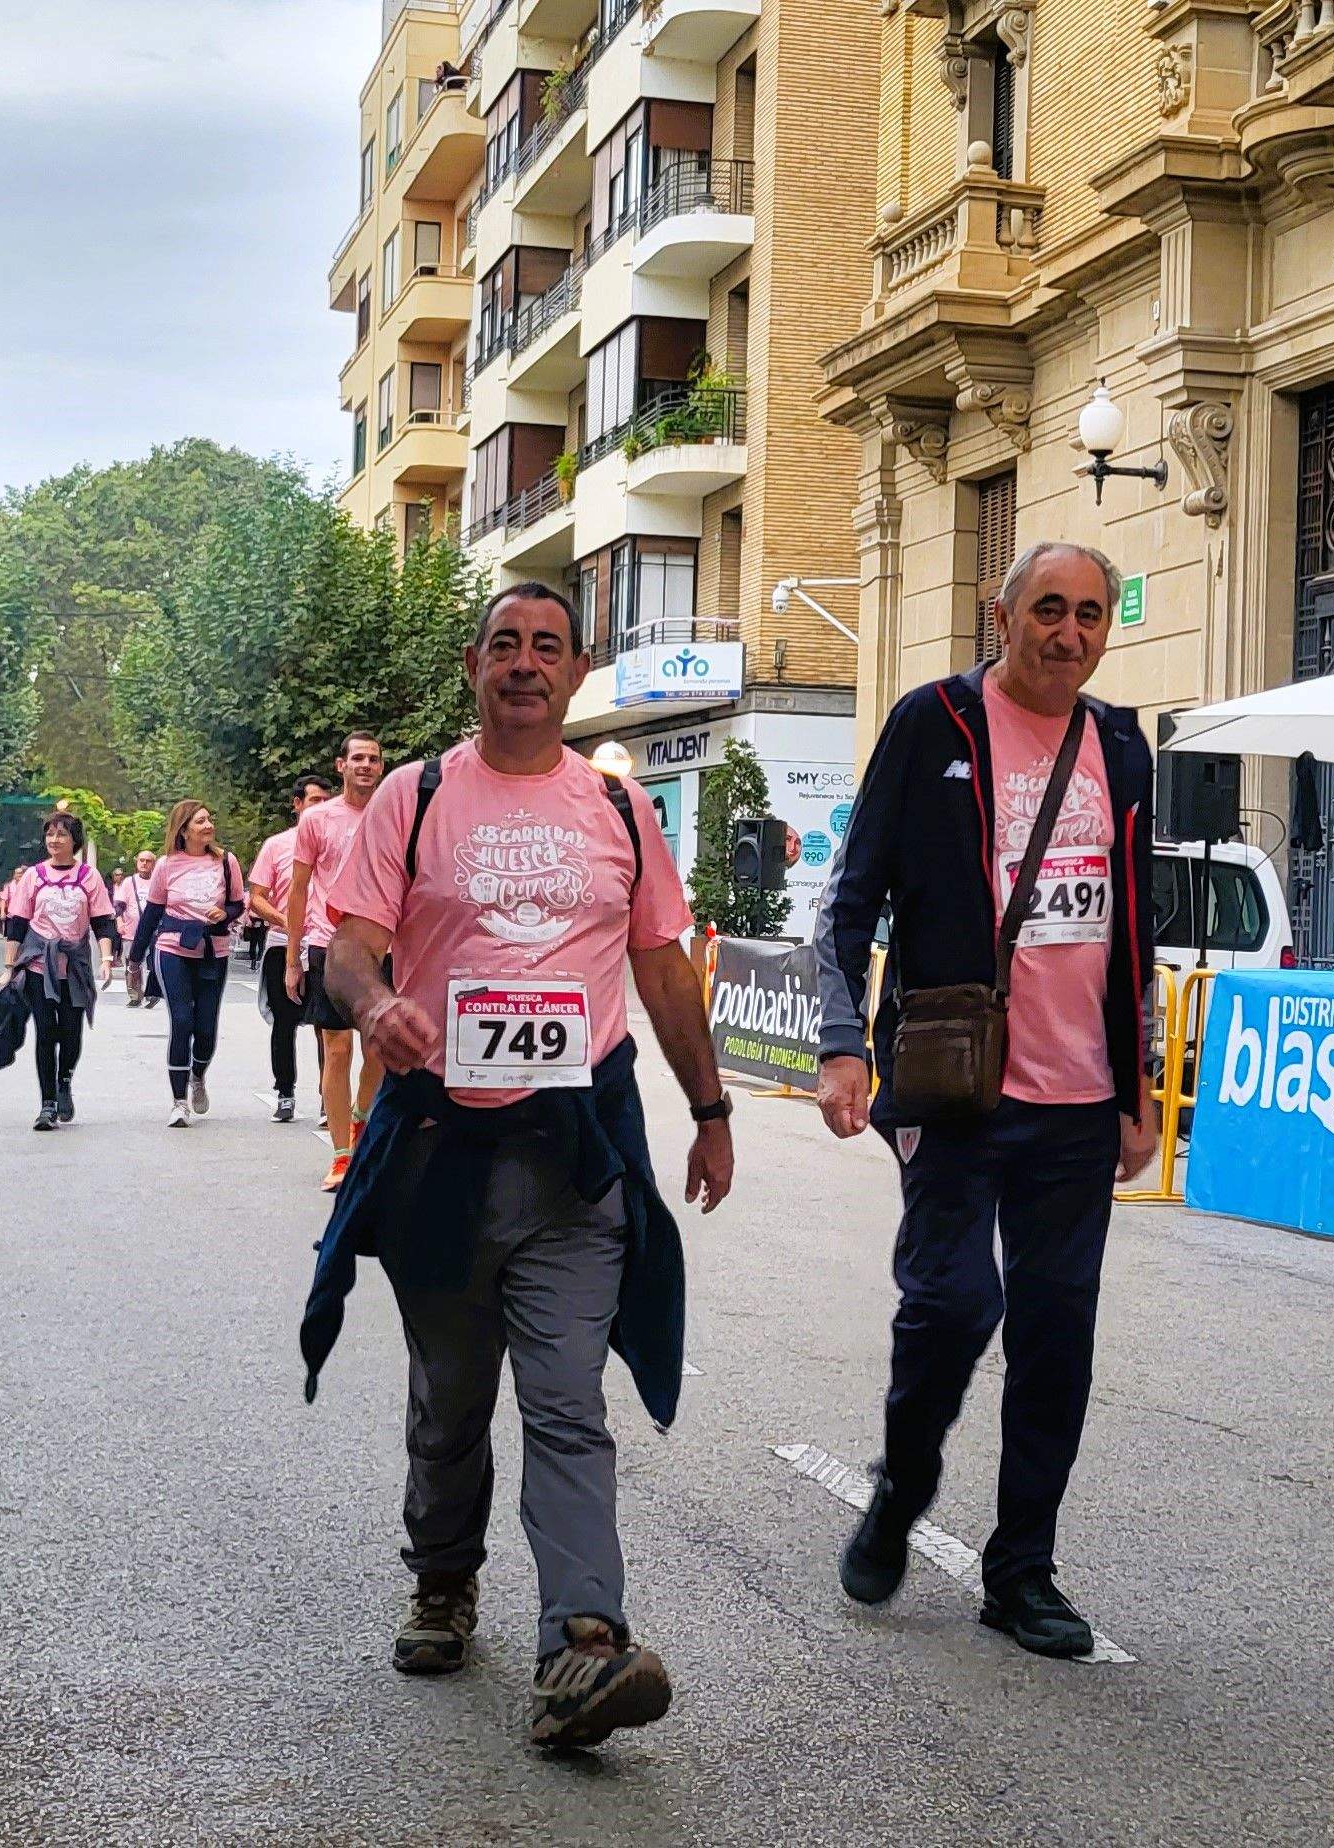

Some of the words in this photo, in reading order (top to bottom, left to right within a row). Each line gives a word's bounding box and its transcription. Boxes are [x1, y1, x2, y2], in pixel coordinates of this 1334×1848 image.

[646, 732, 710, 766] VITALDENT
[1023, 882, 1107, 920] 2491
[465, 1001, 517, 1014] CONTRA
[519, 1003, 533, 1014] EL
[535, 1000, 580, 1014] CÁNCER
[507, 993, 543, 1003] HUESCA
[710, 969, 823, 1044] podoactiva
[478, 1020, 567, 1061] 749
[723, 1035, 763, 1063] PODOLOGÍA
[764, 1044, 770, 1063] Y
[769, 1045, 818, 1075] BIOMECÁNICA
